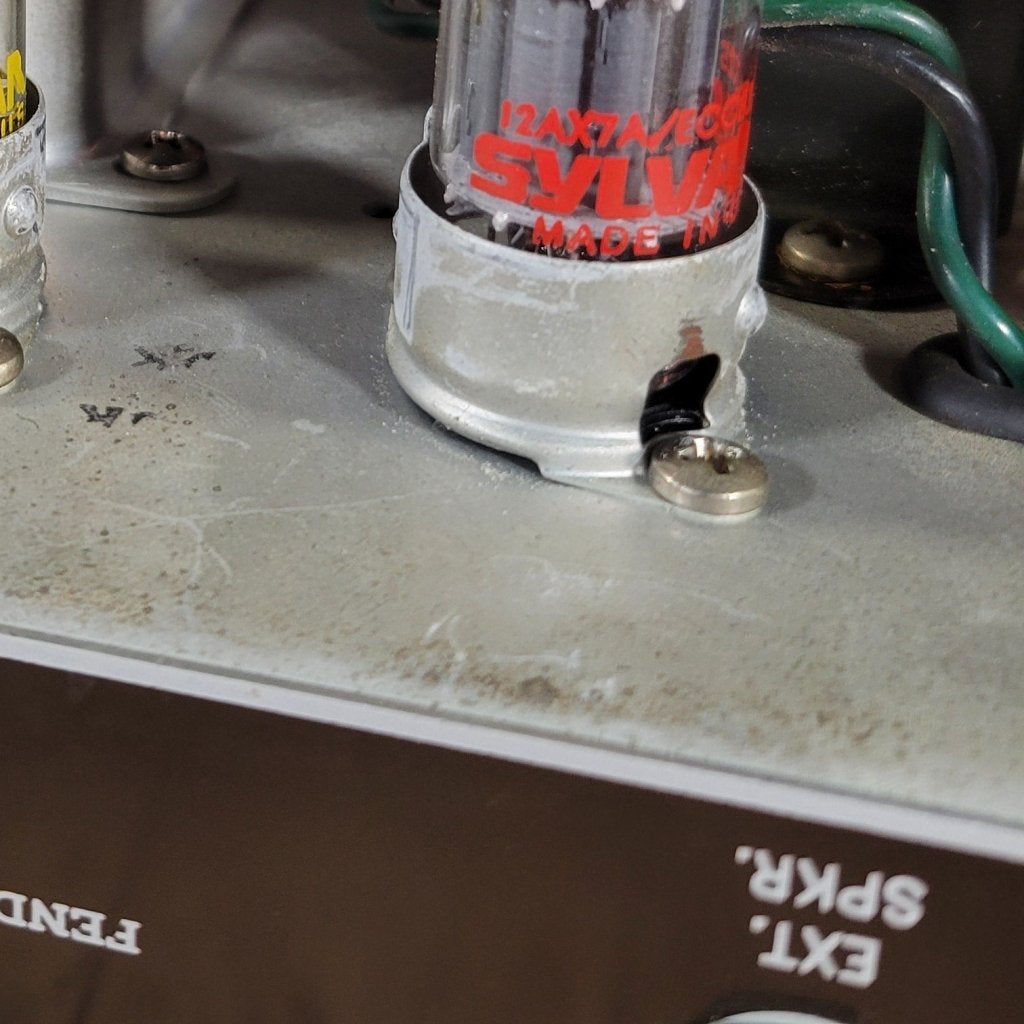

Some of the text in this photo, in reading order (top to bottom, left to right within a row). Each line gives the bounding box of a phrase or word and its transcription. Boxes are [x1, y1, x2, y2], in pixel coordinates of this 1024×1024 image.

[531, 212, 721, 258] MADE IN
[733, 844, 930, 931] SPKR.
[748, 913, 883, 989] EXT.
